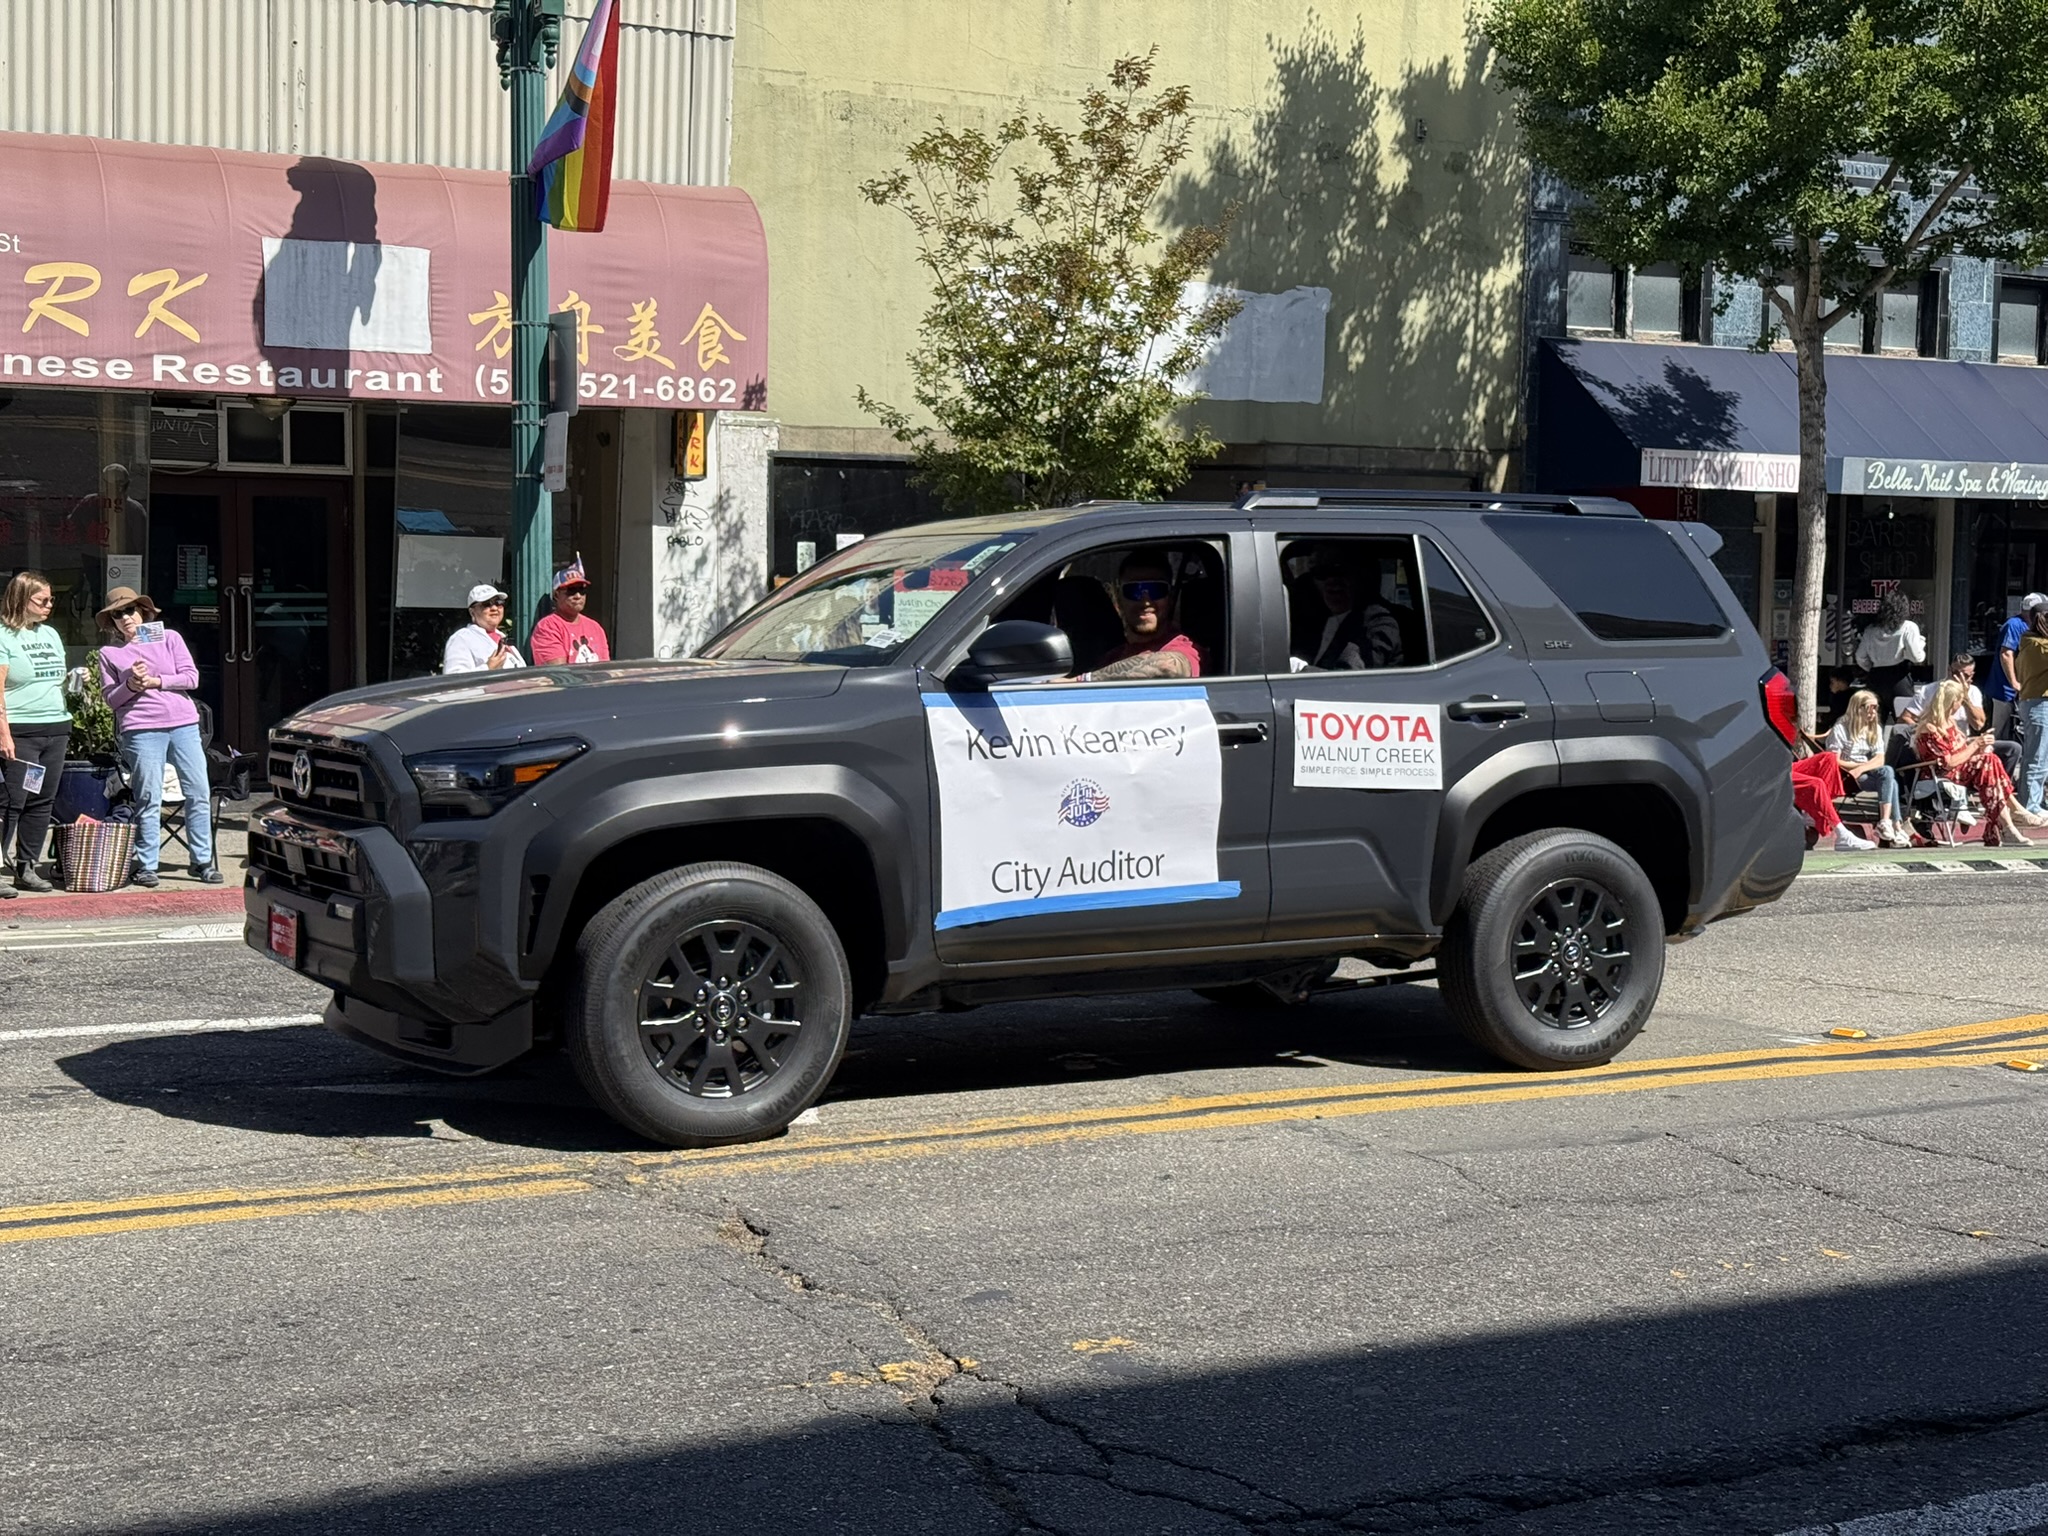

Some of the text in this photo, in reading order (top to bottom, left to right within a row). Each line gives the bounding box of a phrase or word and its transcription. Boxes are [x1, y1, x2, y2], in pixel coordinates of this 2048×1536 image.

[3, 353, 134, 380] nese
[152, 354, 443, 394] Restaurant
[578, 373, 737, 404] 521-6862
[1648, 455, 1698, 485] LITTLE
[1767, 461, 1797, 489] SHO
[1867, 461, 1914, 491] Bella
[1914, 463, 1953, 493] Nail
[1955, 467, 1983, 497] Spa
[1986, 466, 2000, 493] &
[1871, 579, 1901, 598] TK
[965, 723, 1186, 761] Kevin Kearney
[1299, 712, 1434, 743] TOYOTA
[1301, 745, 1435, 764] WALNUT CREEK
[1300, 765, 1331, 775] SIMPLE
[1360, 767, 1392, 777] SIMPLE
[1066, 801, 1095, 819] JULY
[991, 849, 1165, 899] City Auditor
